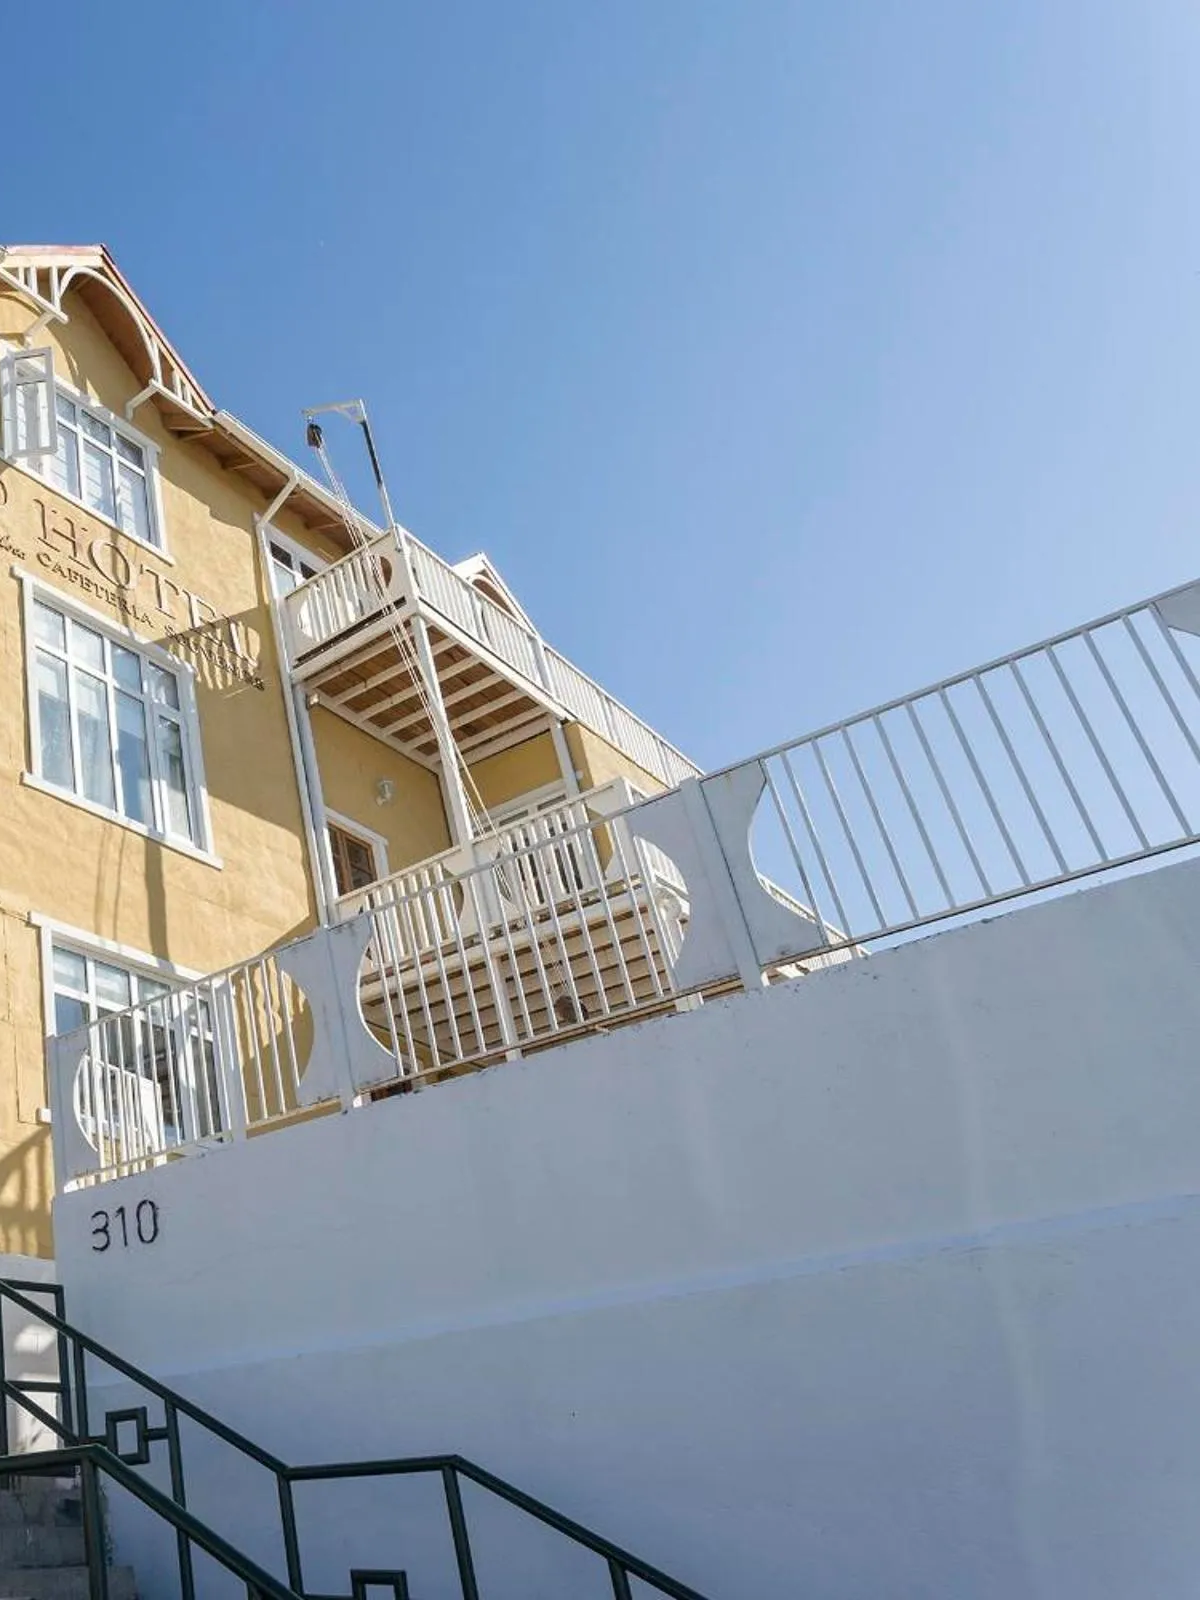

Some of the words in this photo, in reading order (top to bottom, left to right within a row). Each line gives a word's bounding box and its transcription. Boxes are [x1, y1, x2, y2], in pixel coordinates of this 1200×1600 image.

[33, 499, 260, 668] HOTEL
[36, 551, 154, 629] CAFETERIA
[91, 1199, 159, 1252] 310
